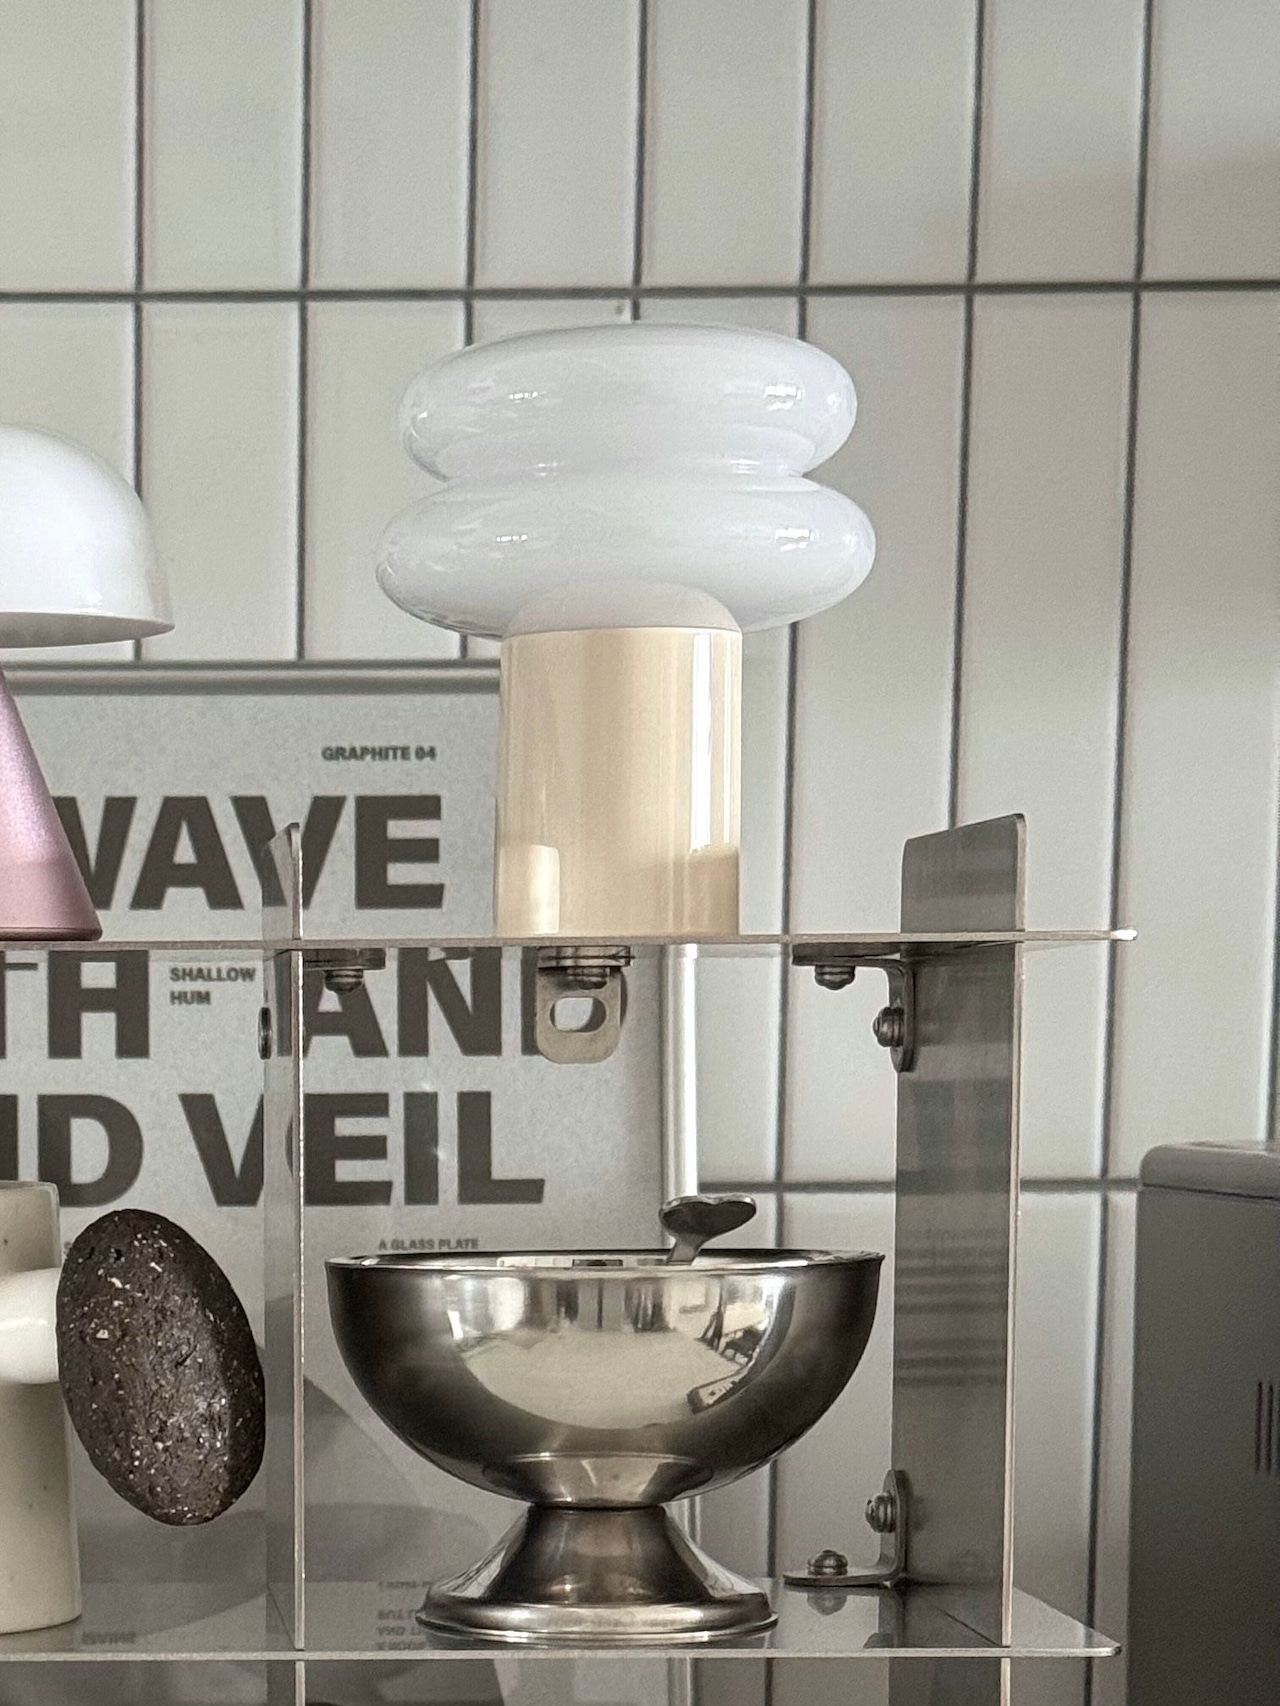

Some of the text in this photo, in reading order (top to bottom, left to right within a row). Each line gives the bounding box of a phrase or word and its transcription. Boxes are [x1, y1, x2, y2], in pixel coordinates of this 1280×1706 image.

[321, 745, 437, 761] GRAPHITE 04
[169, 966, 256, 982] SHALLOW
[169, 990, 211, 1005] HUM
[179, 1091, 545, 1207] VEIL
[378, 1238, 480, 1251] A GLASS PLATE
